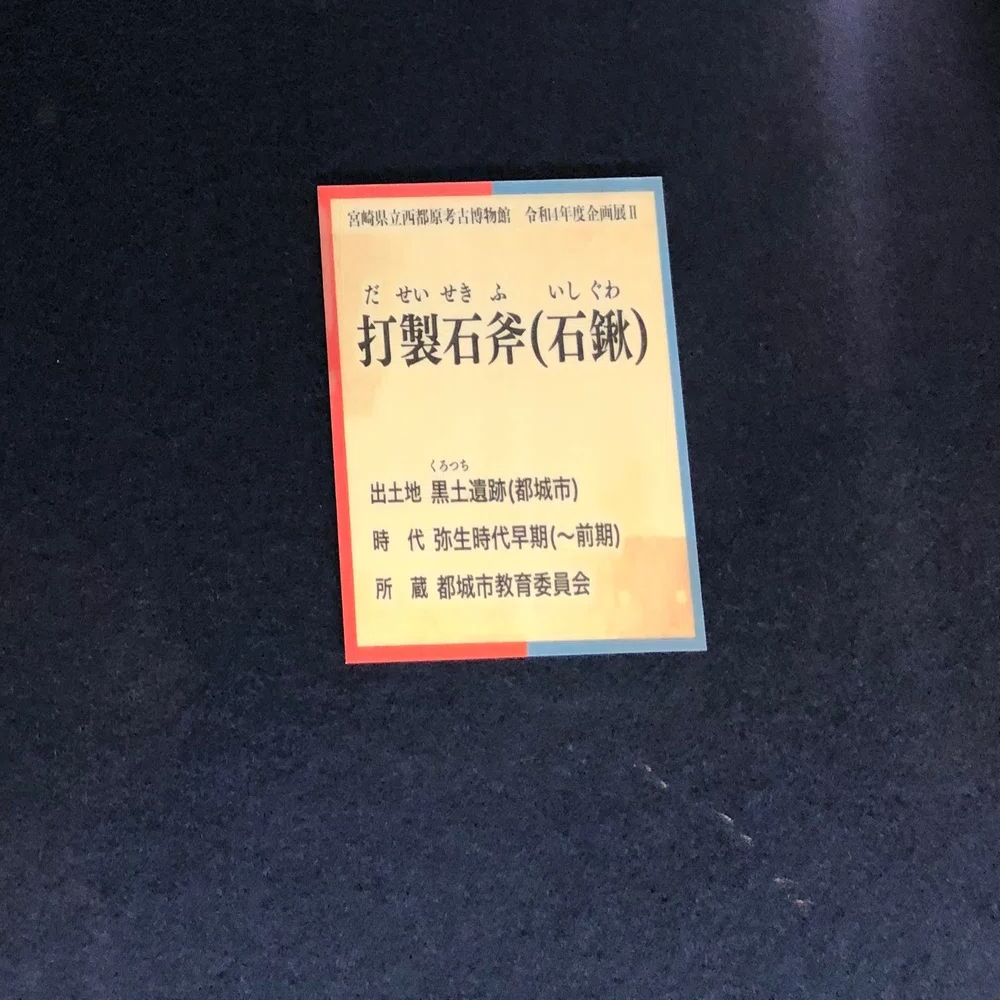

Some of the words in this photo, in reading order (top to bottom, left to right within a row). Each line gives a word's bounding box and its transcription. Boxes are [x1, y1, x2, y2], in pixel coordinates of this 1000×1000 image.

[348, 208, 511, 227] 宮崎県立西都原考古博物館
[364, 284, 379, 304] だ
[396, 285, 429, 304] せい
[440, 283, 472, 302] せき
[490, 283, 507, 301] ふ
[357, 307, 648, 368] 打製石斧(石鍬)
[430, 459, 469, 472] くろつち
[371, 481, 422, 505] 出土地
[431, 476, 578, 504] 黒土遺跡(都城市)
[437, 571, 590, 599] 都城市教育委員会
